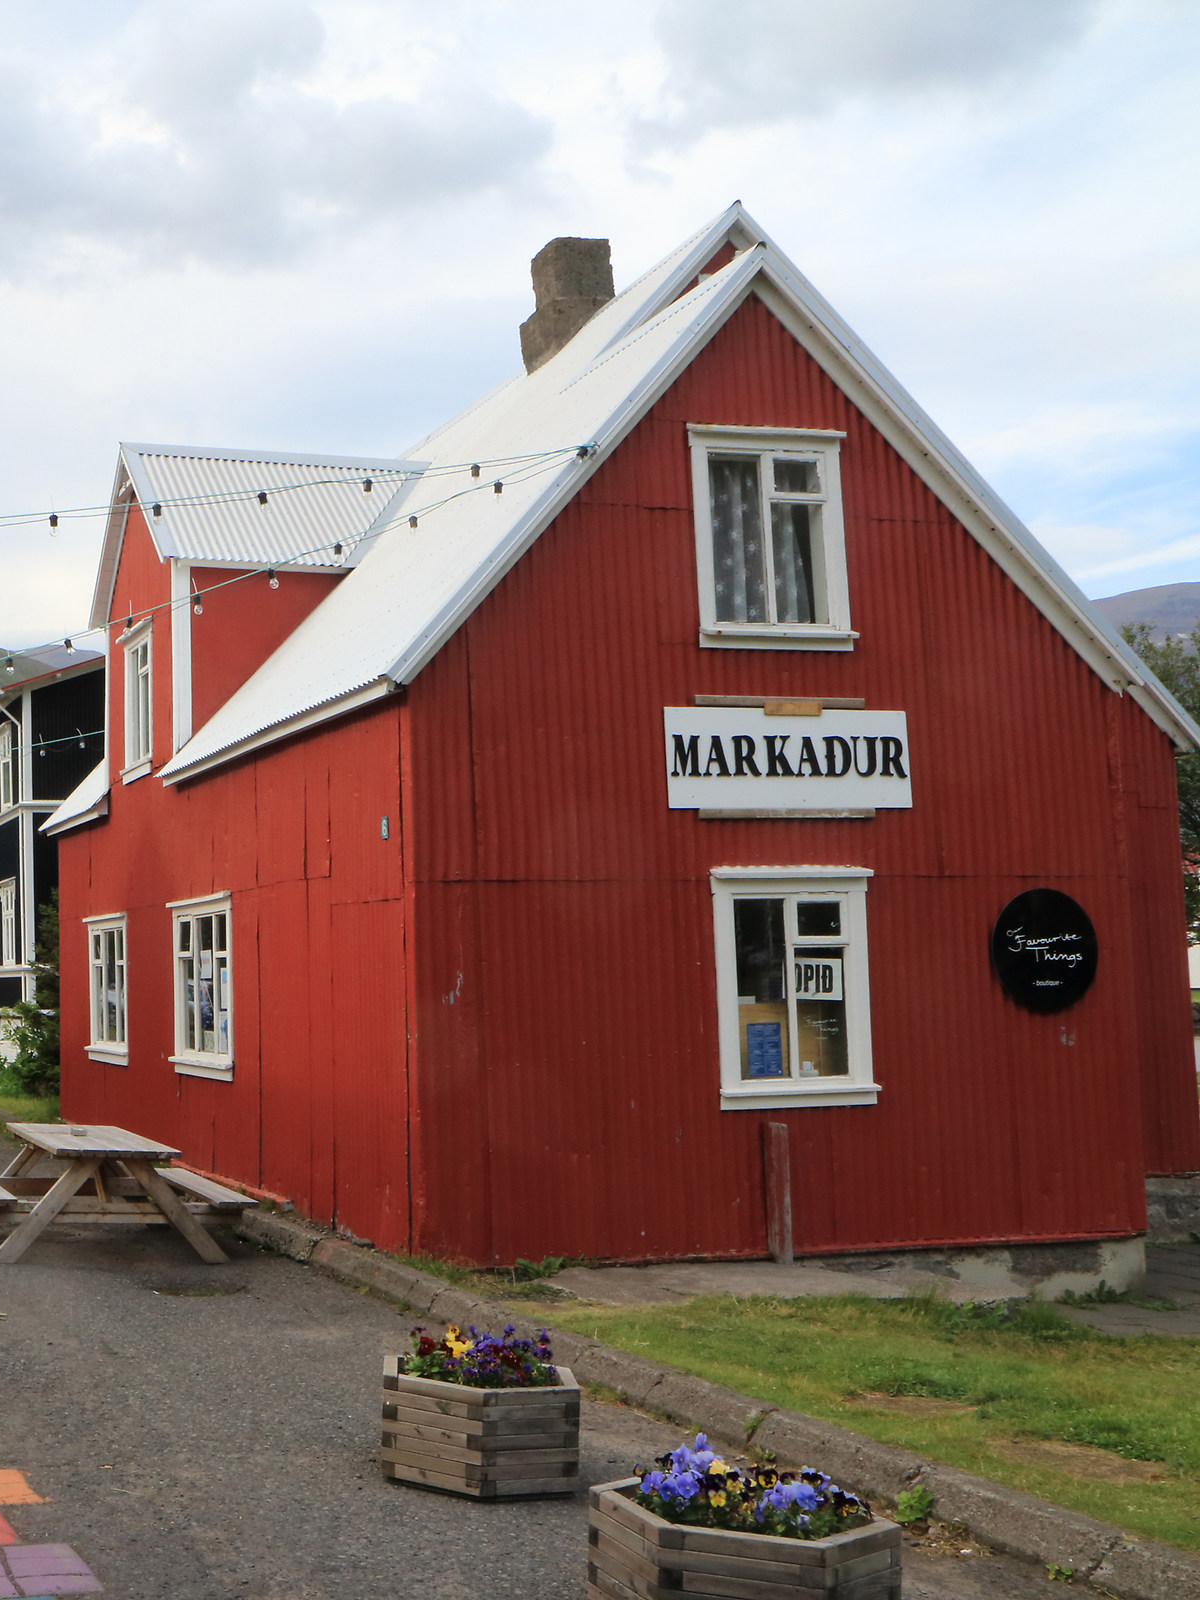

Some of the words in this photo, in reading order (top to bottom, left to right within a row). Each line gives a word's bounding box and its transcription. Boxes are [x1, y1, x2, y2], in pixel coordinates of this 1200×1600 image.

[671, 734, 908, 779] MARKAÐUR
[1008, 933, 1082, 952] Favourite
[1025, 946, 1083, 968] Things
